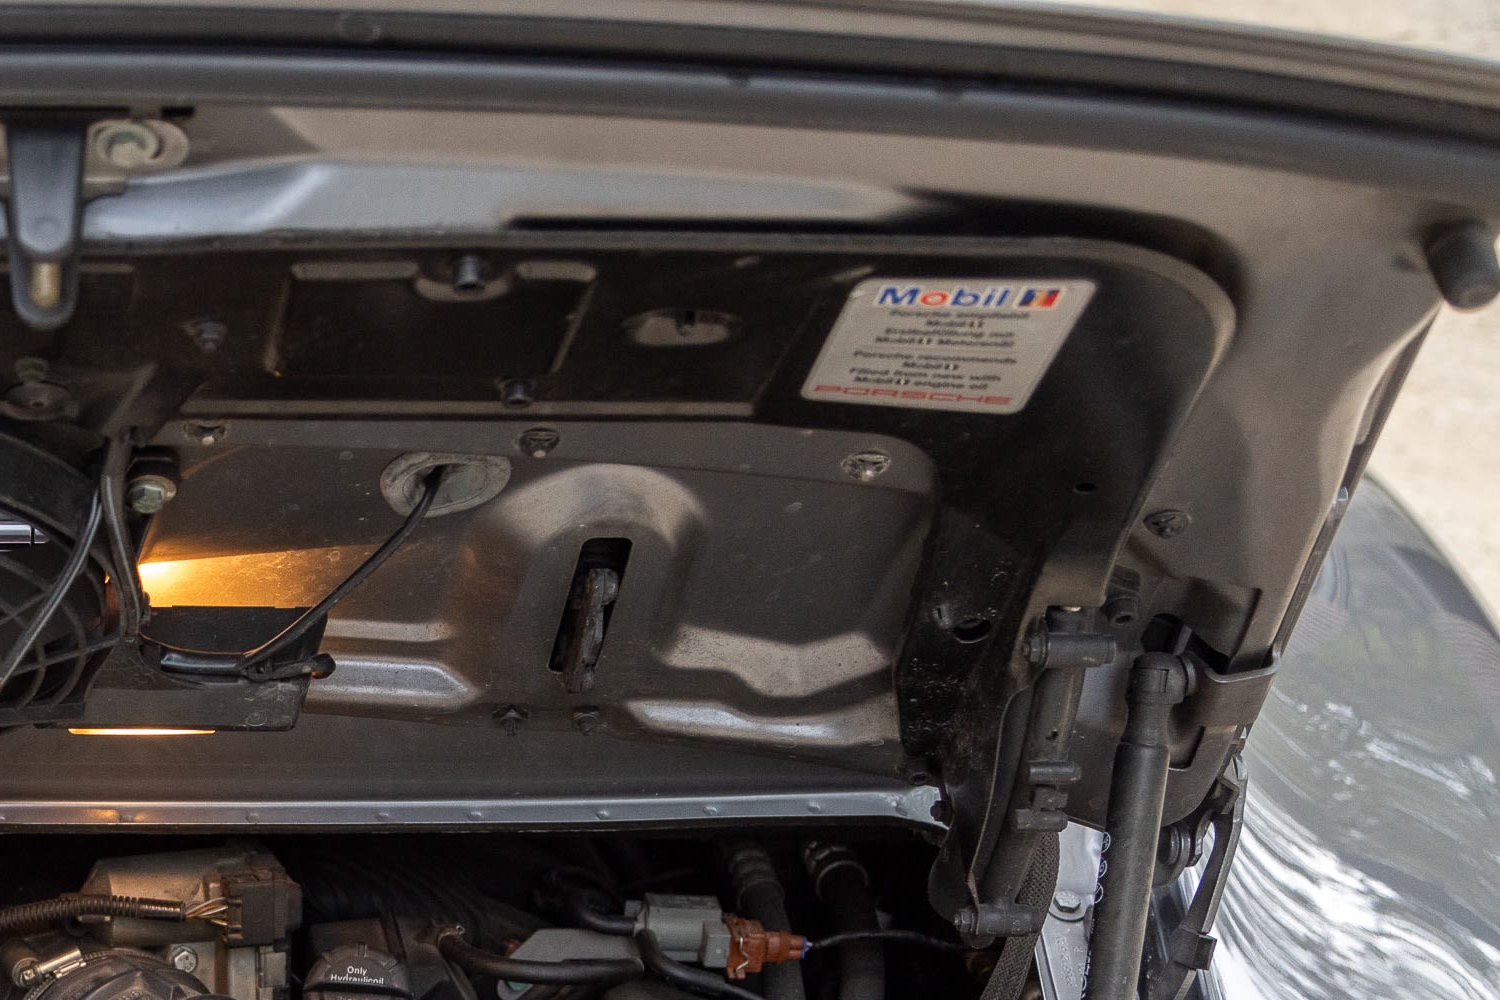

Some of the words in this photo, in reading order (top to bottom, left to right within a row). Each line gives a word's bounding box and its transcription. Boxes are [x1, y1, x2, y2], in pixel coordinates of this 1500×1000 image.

[877, 286, 1011, 307] Mobil
[813, 384, 1013, 406] PORSCHE
[346, 965, 368, 976] Only
